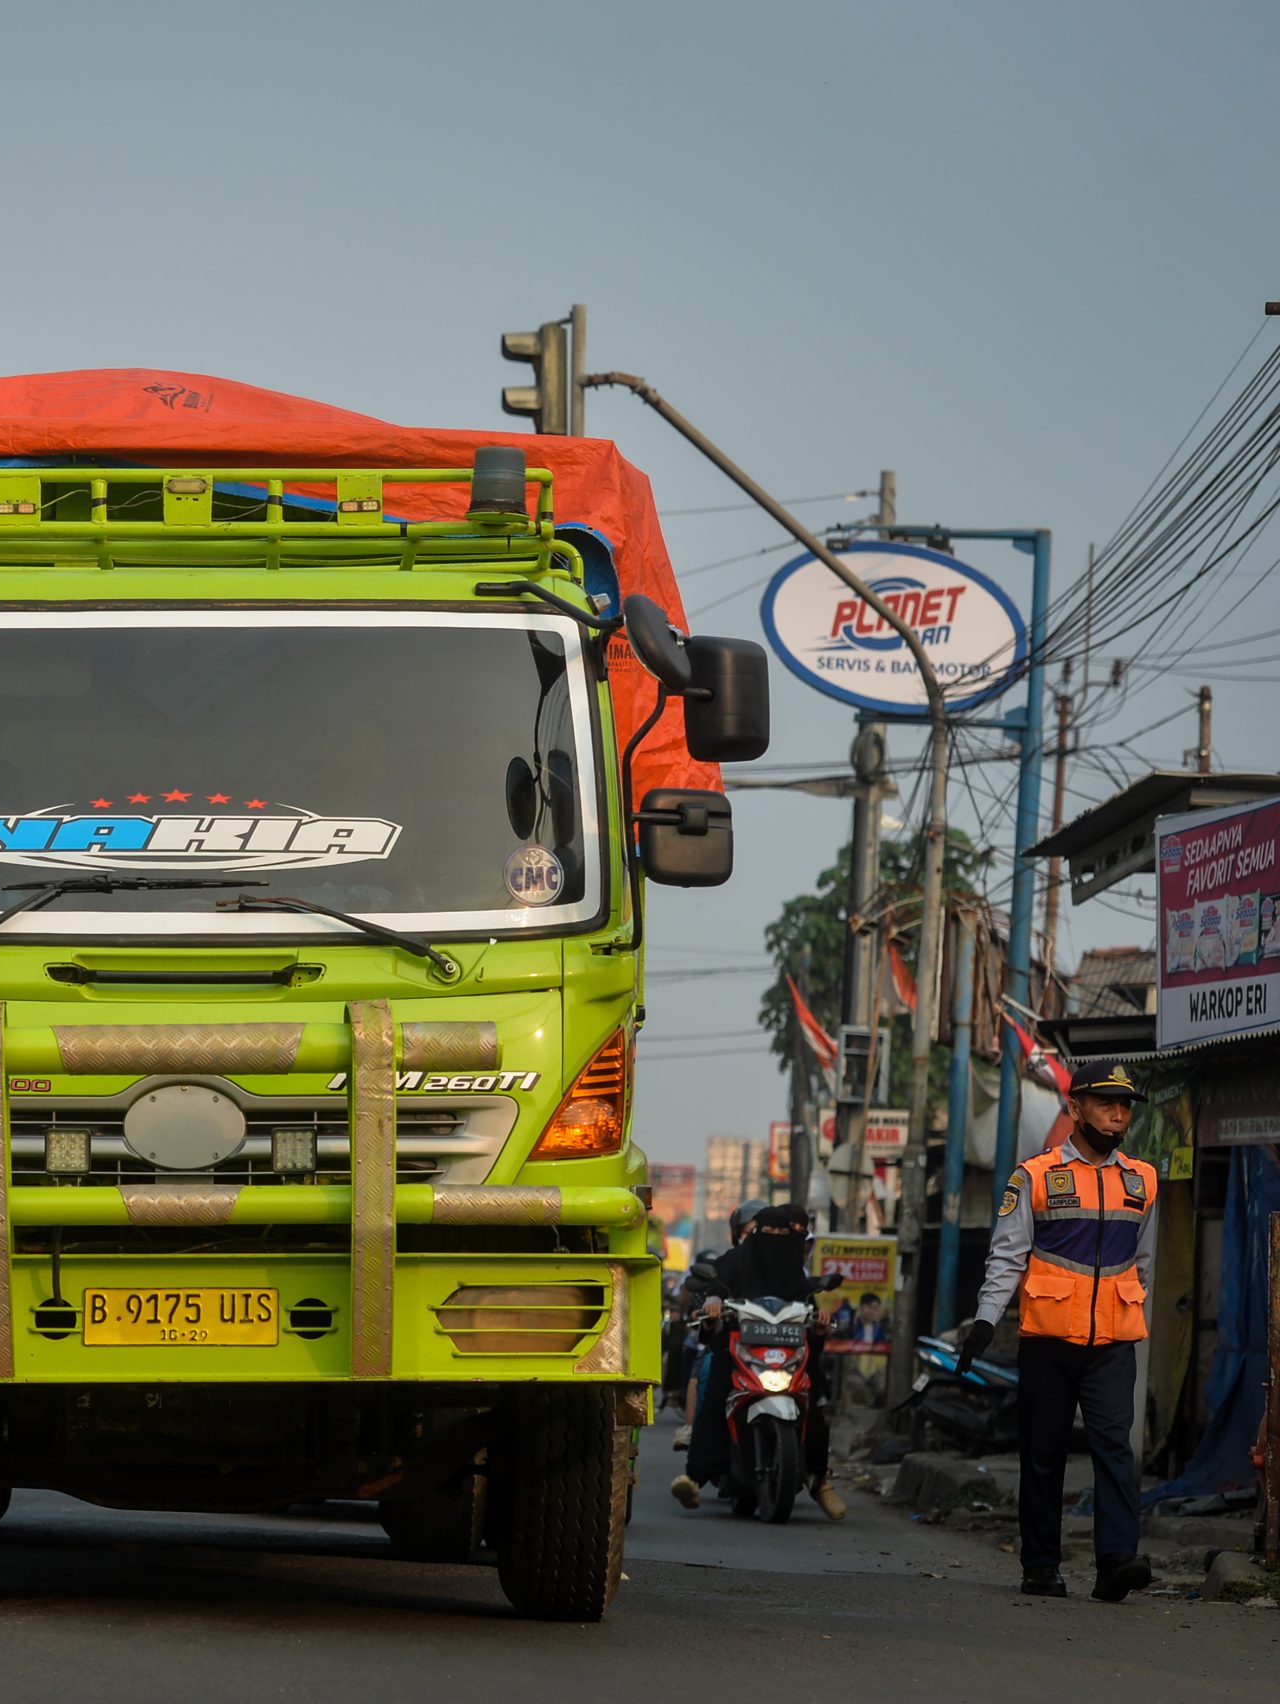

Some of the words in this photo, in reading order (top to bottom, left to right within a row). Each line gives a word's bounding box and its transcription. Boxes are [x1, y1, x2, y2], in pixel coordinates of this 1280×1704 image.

[831, 586, 967, 639] PLANET
[905, 625, 951, 648] AN
[816, 655, 871, 673] SERVIS
[874, 658, 886, 673] &
[1183, 823, 1243, 868] SEDAAPNYA
[1186, 850, 1235, 897] FAVORIT
[1235, 838, 1275, 880] SEMUA
[1189, 982, 1243, 1023] WARKOP
[1246, 982, 1267, 1017] ERI
[8, 1078, 51, 1091] 00
[91, 1294, 107, 1324] B
[126, 1294, 202, 1324] 9175
[220, 1293, 271, 1324] UIS
